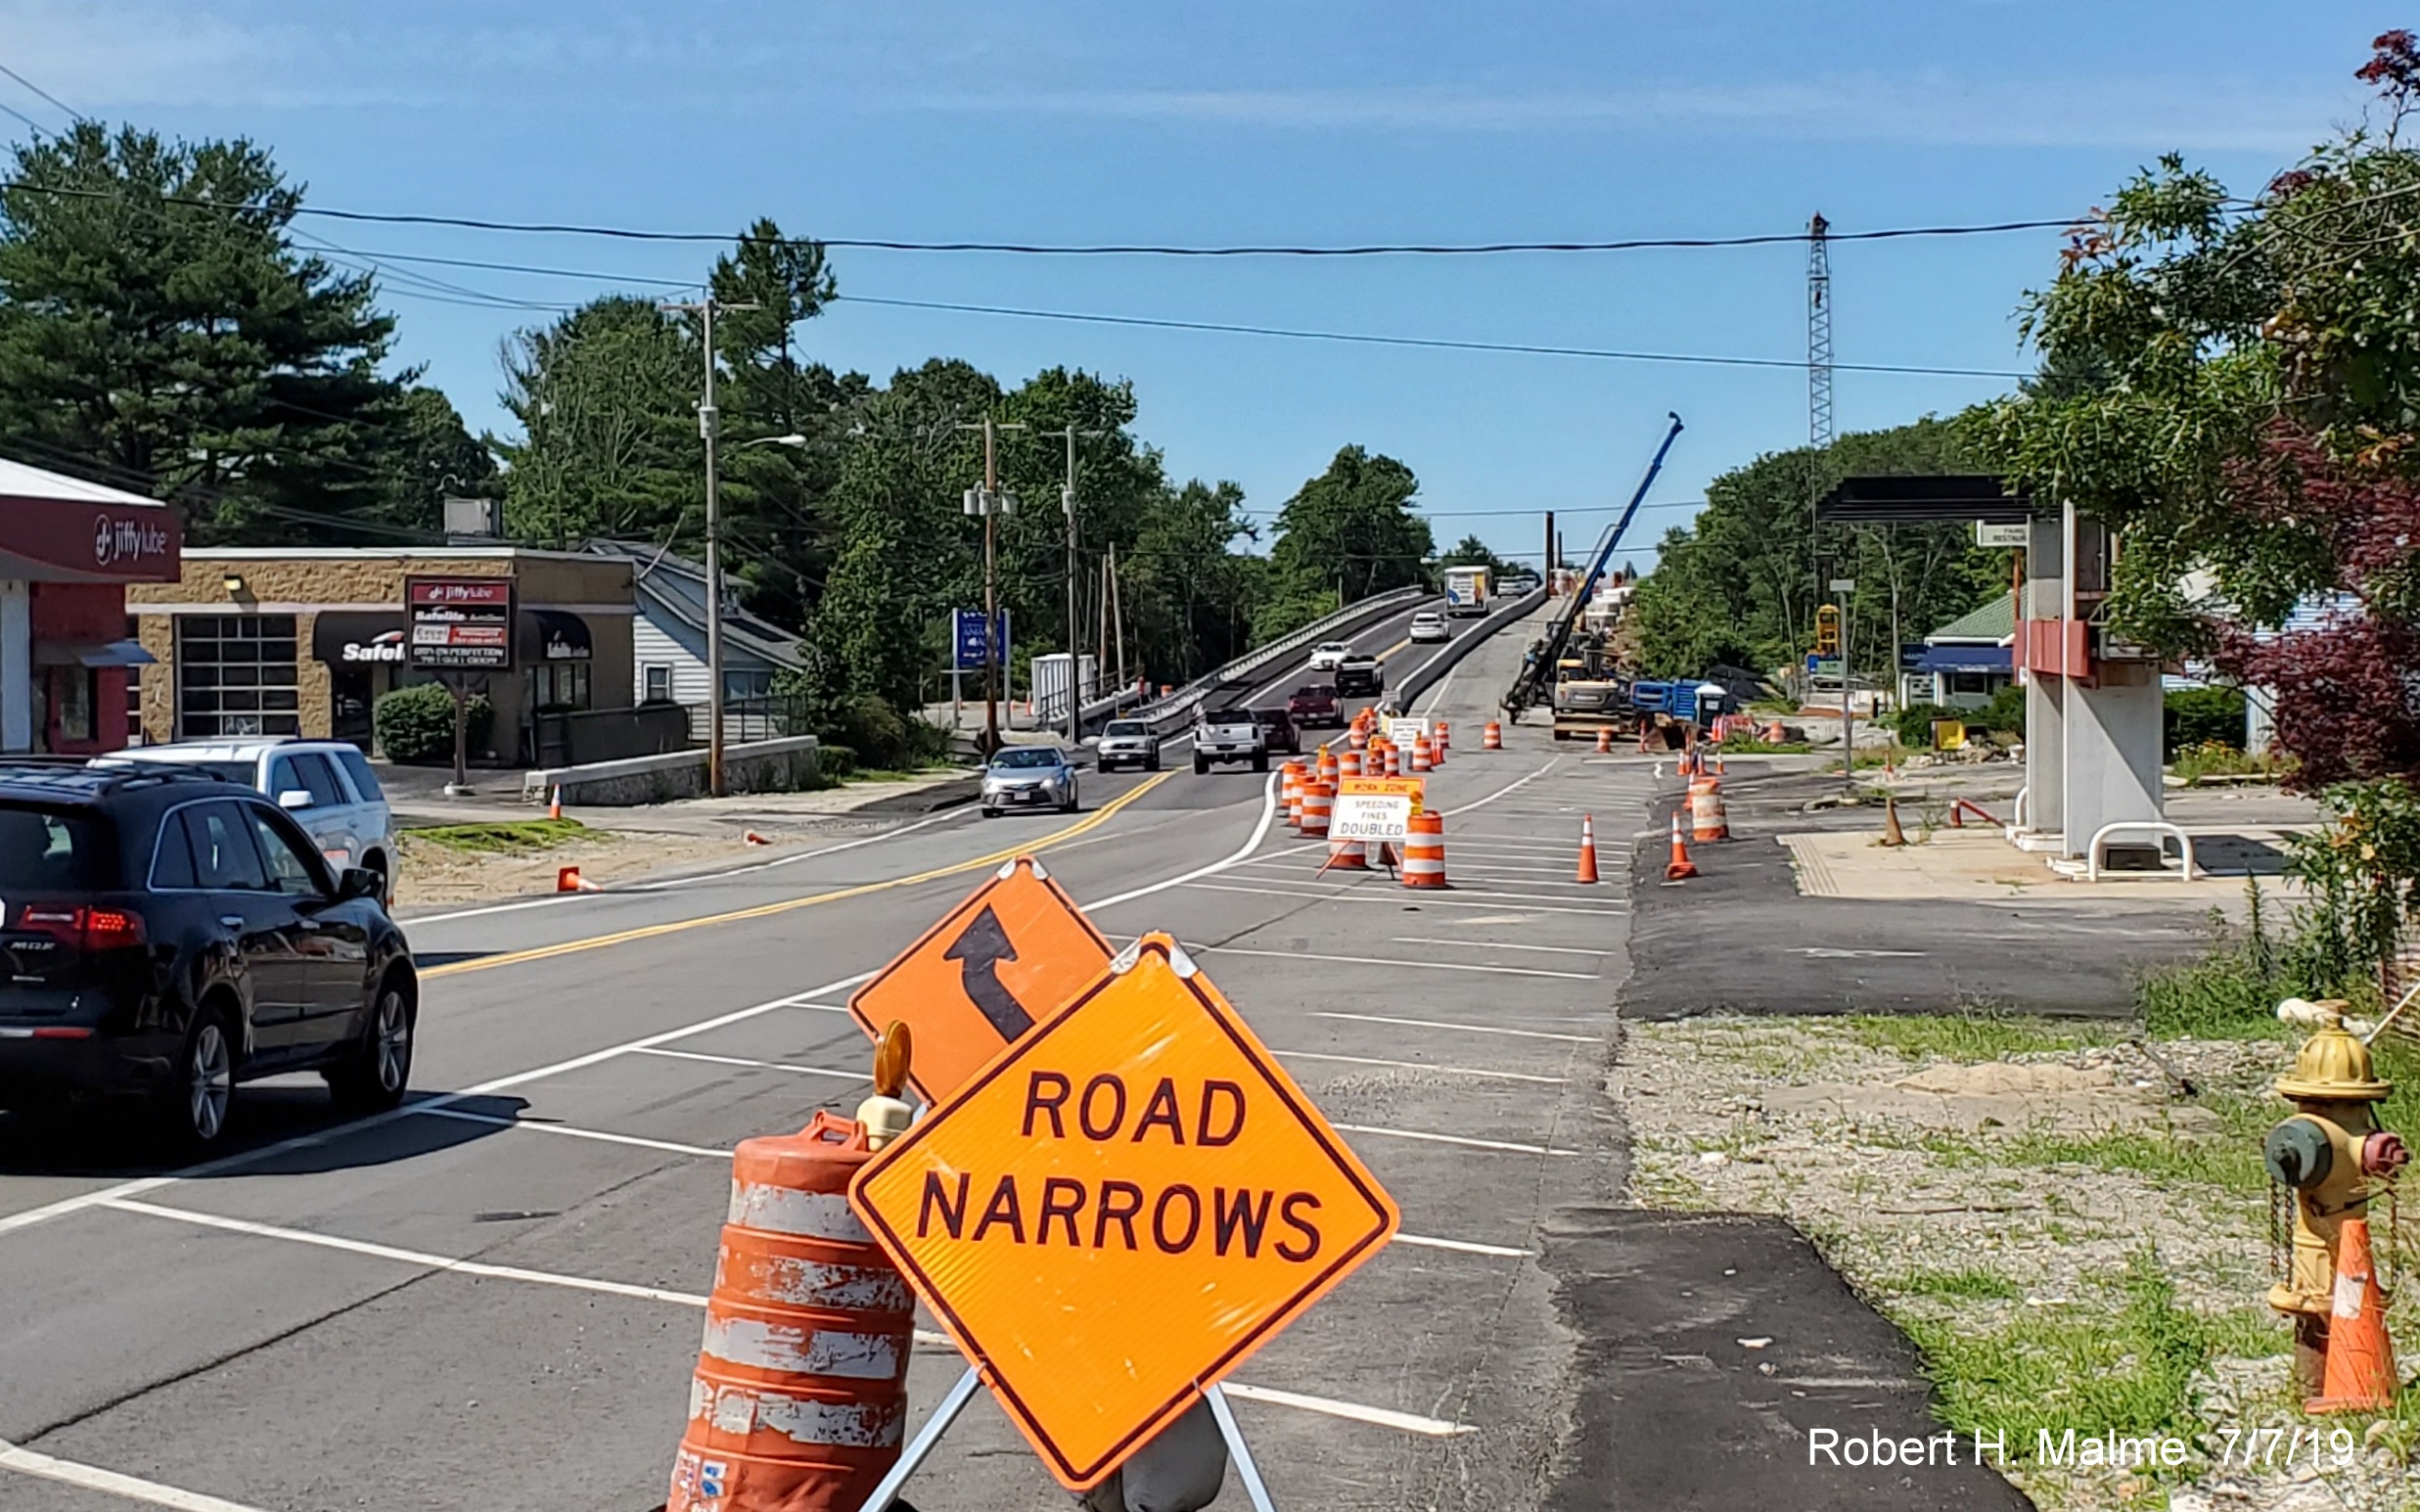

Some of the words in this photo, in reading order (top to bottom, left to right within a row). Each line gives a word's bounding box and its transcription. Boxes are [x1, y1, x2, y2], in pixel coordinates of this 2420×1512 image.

[1385, 784, 1408, 793] ZONE
[1355, 801, 1399, 810] SPEEDING
[1361, 811, 1388, 821] FINES
[1340, 822, 1403, 836] DOUBLED
[1021, 1071, 1247, 1148] ROAD
[916, 1169, 1324, 1263] NARROWS
